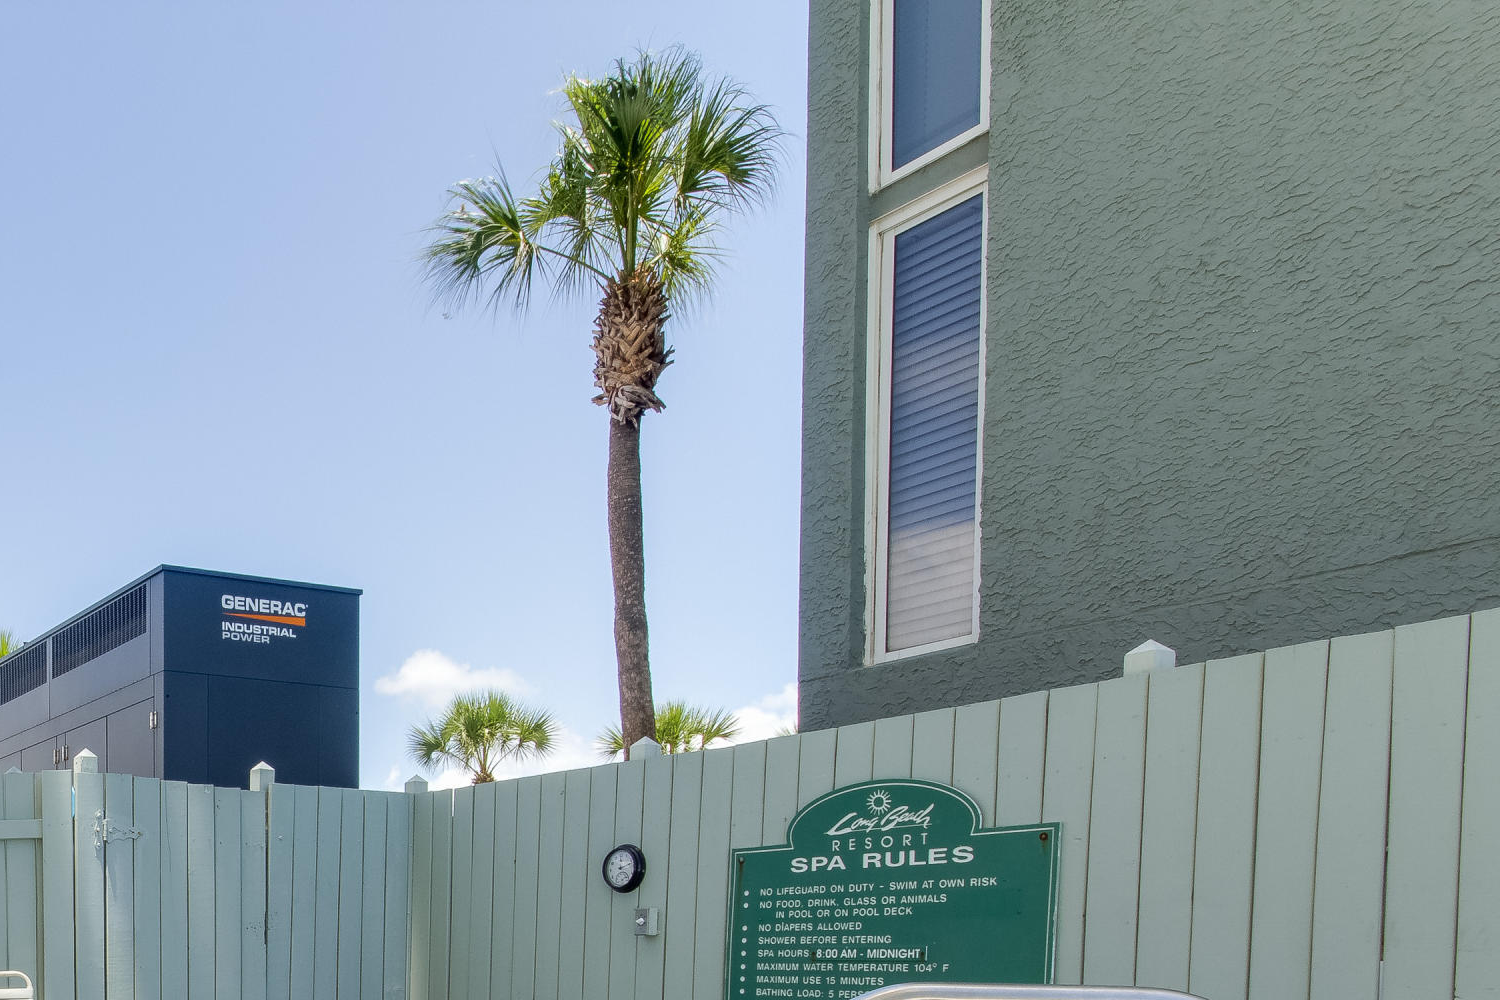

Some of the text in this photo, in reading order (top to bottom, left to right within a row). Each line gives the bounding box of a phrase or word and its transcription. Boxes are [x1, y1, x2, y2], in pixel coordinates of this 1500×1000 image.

[221, 594, 306, 617] GENERAC
[222, 621, 296, 638] INDUSTRIAL
[222, 631, 270, 644] POWER
[825, 803, 935, 835] Long Beach
[832, 833, 928, 851] RESORT
[790, 846, 974, 873] SPA RULES
[760, 888, 772, 896] NO
[777, 885, 826, 895] LIFEGUARD
[830, 885, 844, 893] ON
[848, 883, 874, 892] DUTY
[889, 881, 917, 891] SWIM
[922, 880, 934, 889] AT
[939, 879, 964, 888] OWN
[970, 877, 998, 887] RISK
[760, 901, 772, 909] NO
[843, 897, 877, 906] GLASS
[881, 896, 896, 904] OR
[900, 894, 947, 904] ANIMALS
[776, 907, 913, 919] IN POOL OR ON POOL DECK
[758, 922, 862, 932] NO DIAPERS ALLOWED
[758, 935, 892, 945] SHOWER BEFORE ENTERING
[757, 950, 774, 958] SPA
[816, 949, 838, 958] 8:00
[840, 949, 857, 958] AM
[867, 948, 920, 959] MIDNIGHT
[757, 963, 799, 971] MAXIMUM
[803, 963, 834, 971] WATER
[838, 963, 909, 972] TEMPERATURE
[942, 964, 949, 973] F
[756, 976, 884, 986] MAXIMUM USE 15 MINUTES
[756, 989, 793, 997] BATHING
[797, 989, 824, 998] LOAD:
[828, 990, 834, 998] 5
